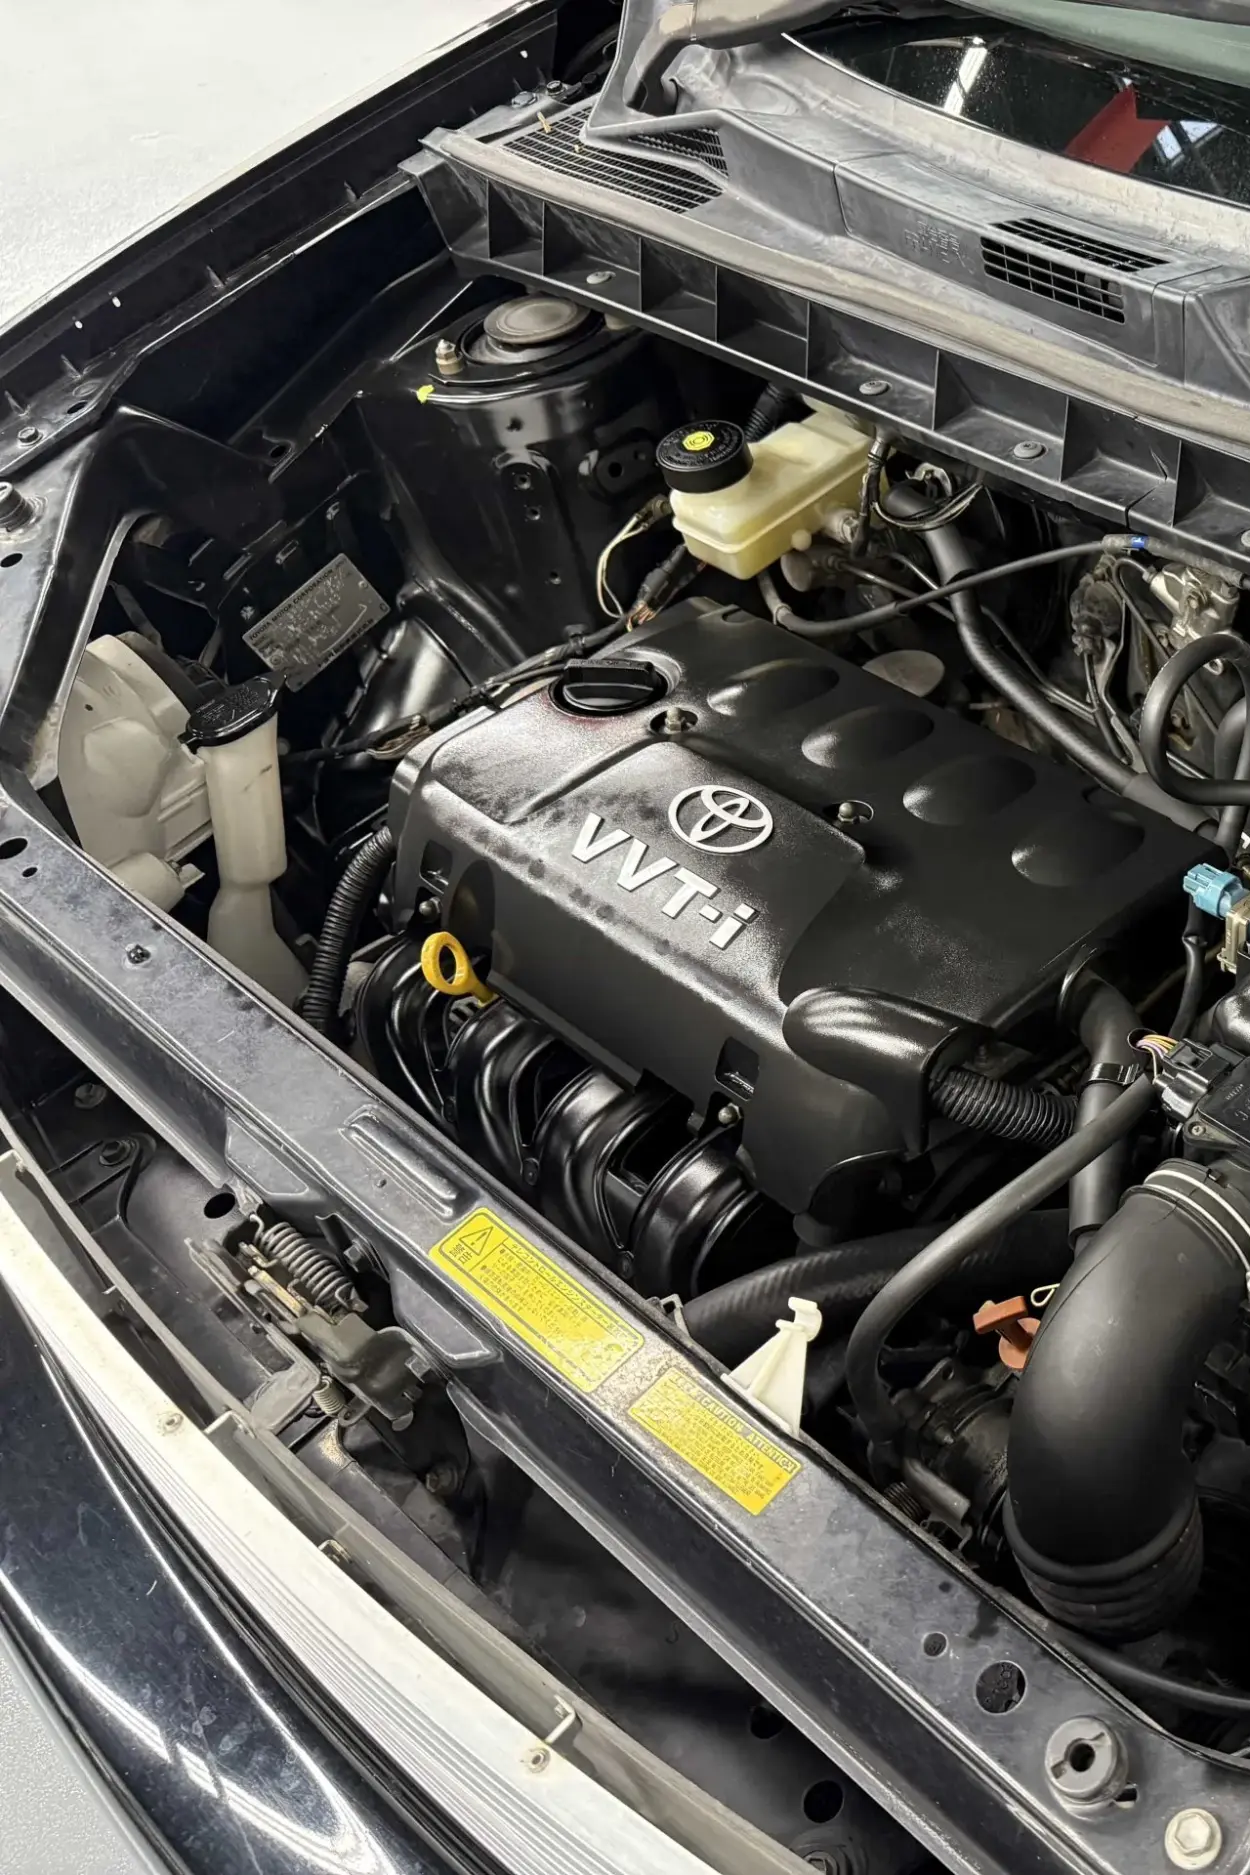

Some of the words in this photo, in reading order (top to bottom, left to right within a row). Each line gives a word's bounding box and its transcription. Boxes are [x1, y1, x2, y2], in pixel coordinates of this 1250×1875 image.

[249, 621, 271, 642] TOYOTA
[271, 603, 293, 623] MOTOR
[293, 568, 333, 604] CORPORATION
[571, 812, 758, 950] VVT-i
[701, 1397, 744, 1433] CAUTION
